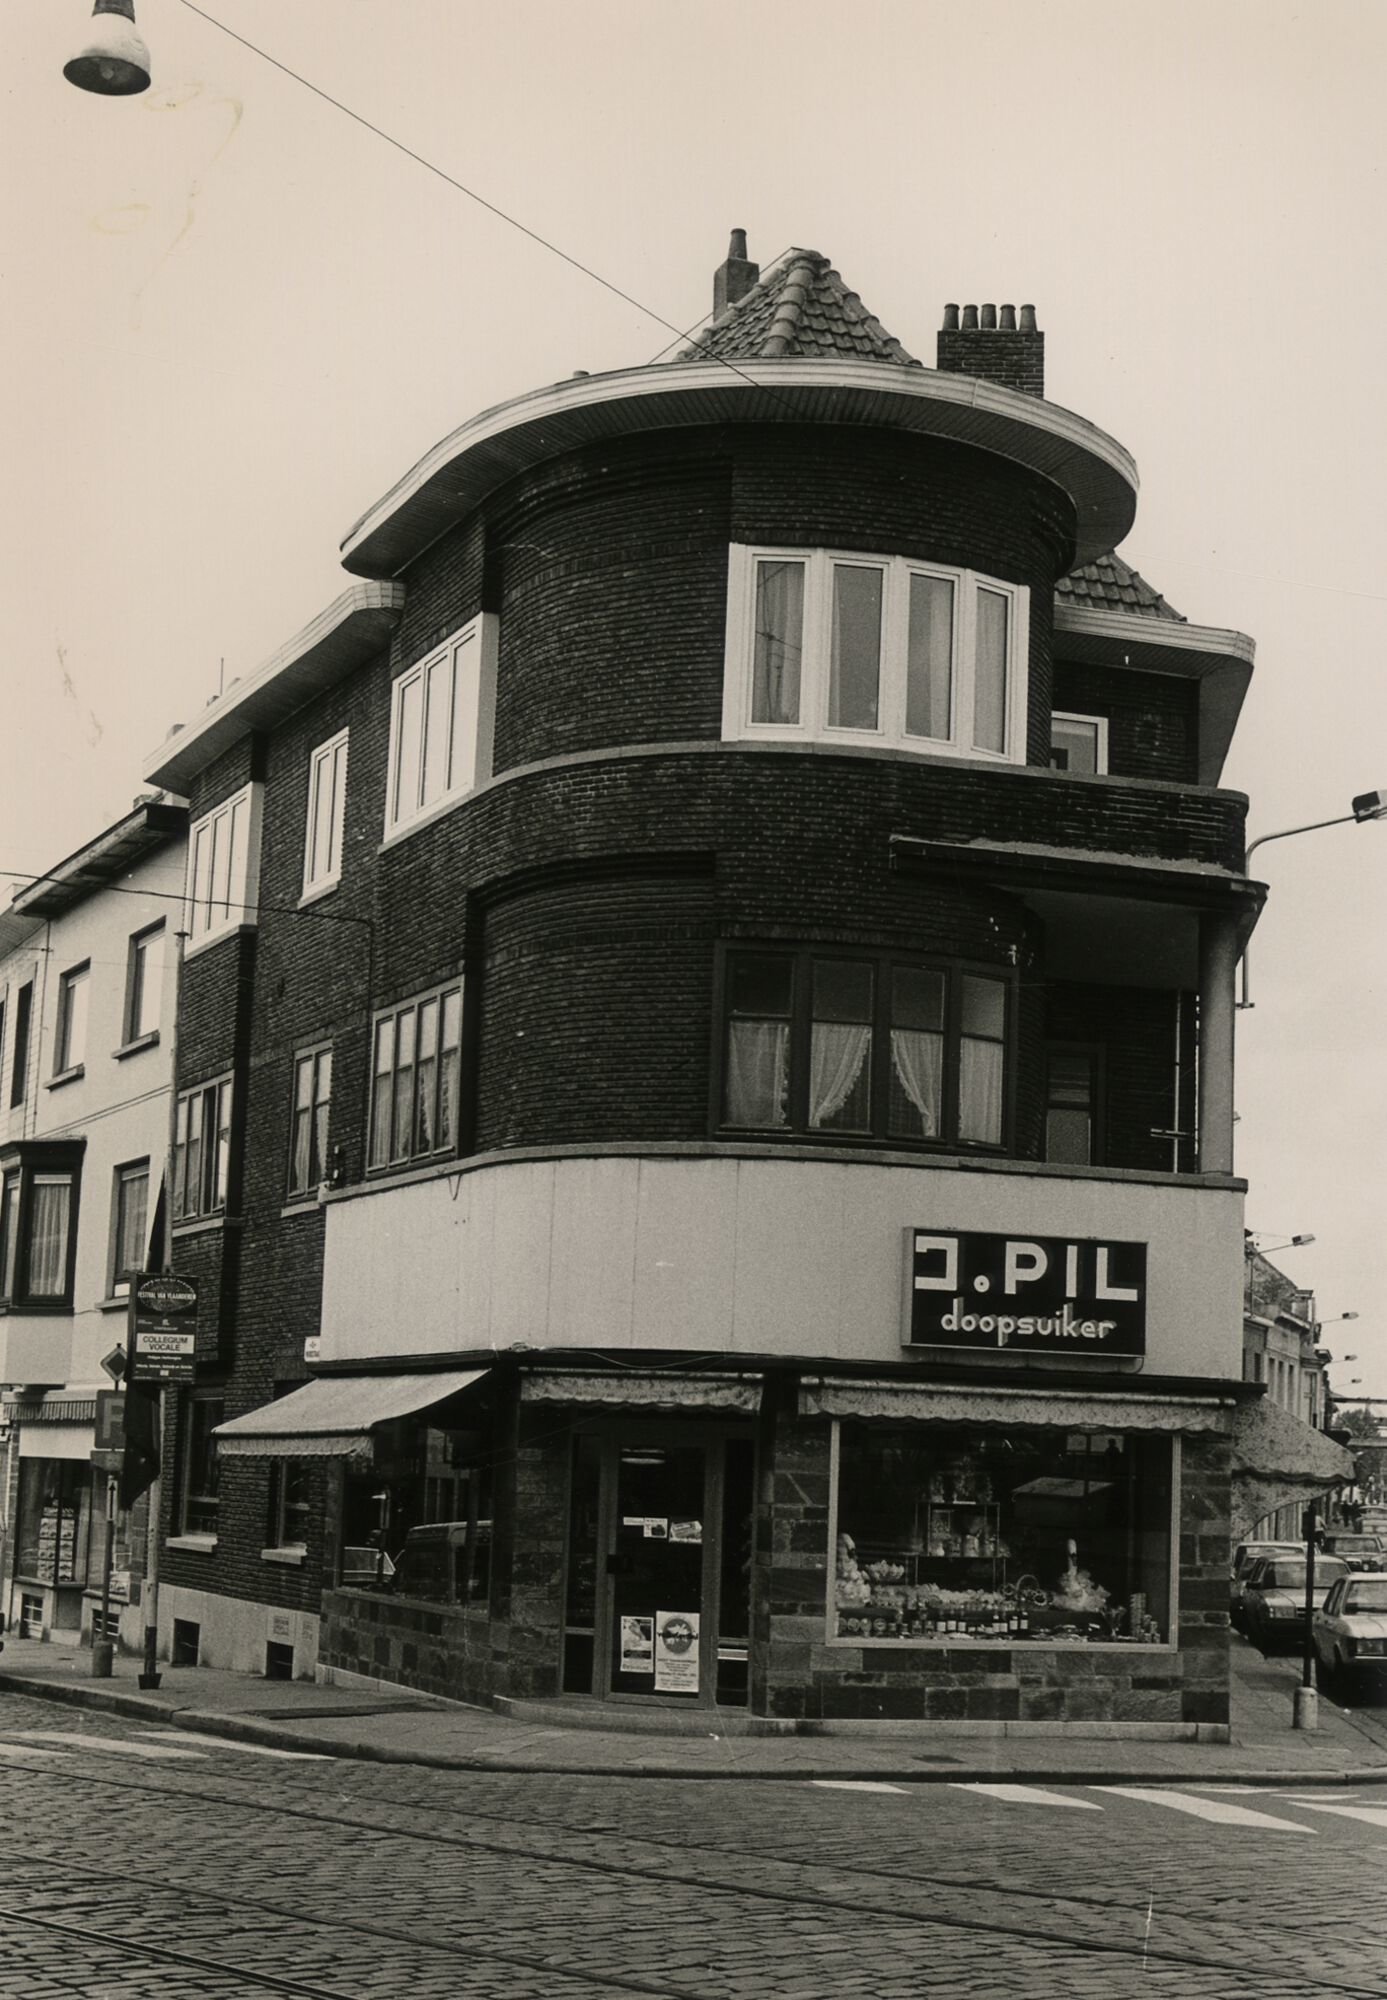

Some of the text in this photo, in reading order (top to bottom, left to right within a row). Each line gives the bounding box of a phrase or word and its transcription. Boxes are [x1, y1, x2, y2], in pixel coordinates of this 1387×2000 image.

[137, 1291, 156, 1299] FESTIVAL
[941, 1297, 1117, 1347] doopsuiker
[142, 1335, 188, 1344] COLLEGIUM
